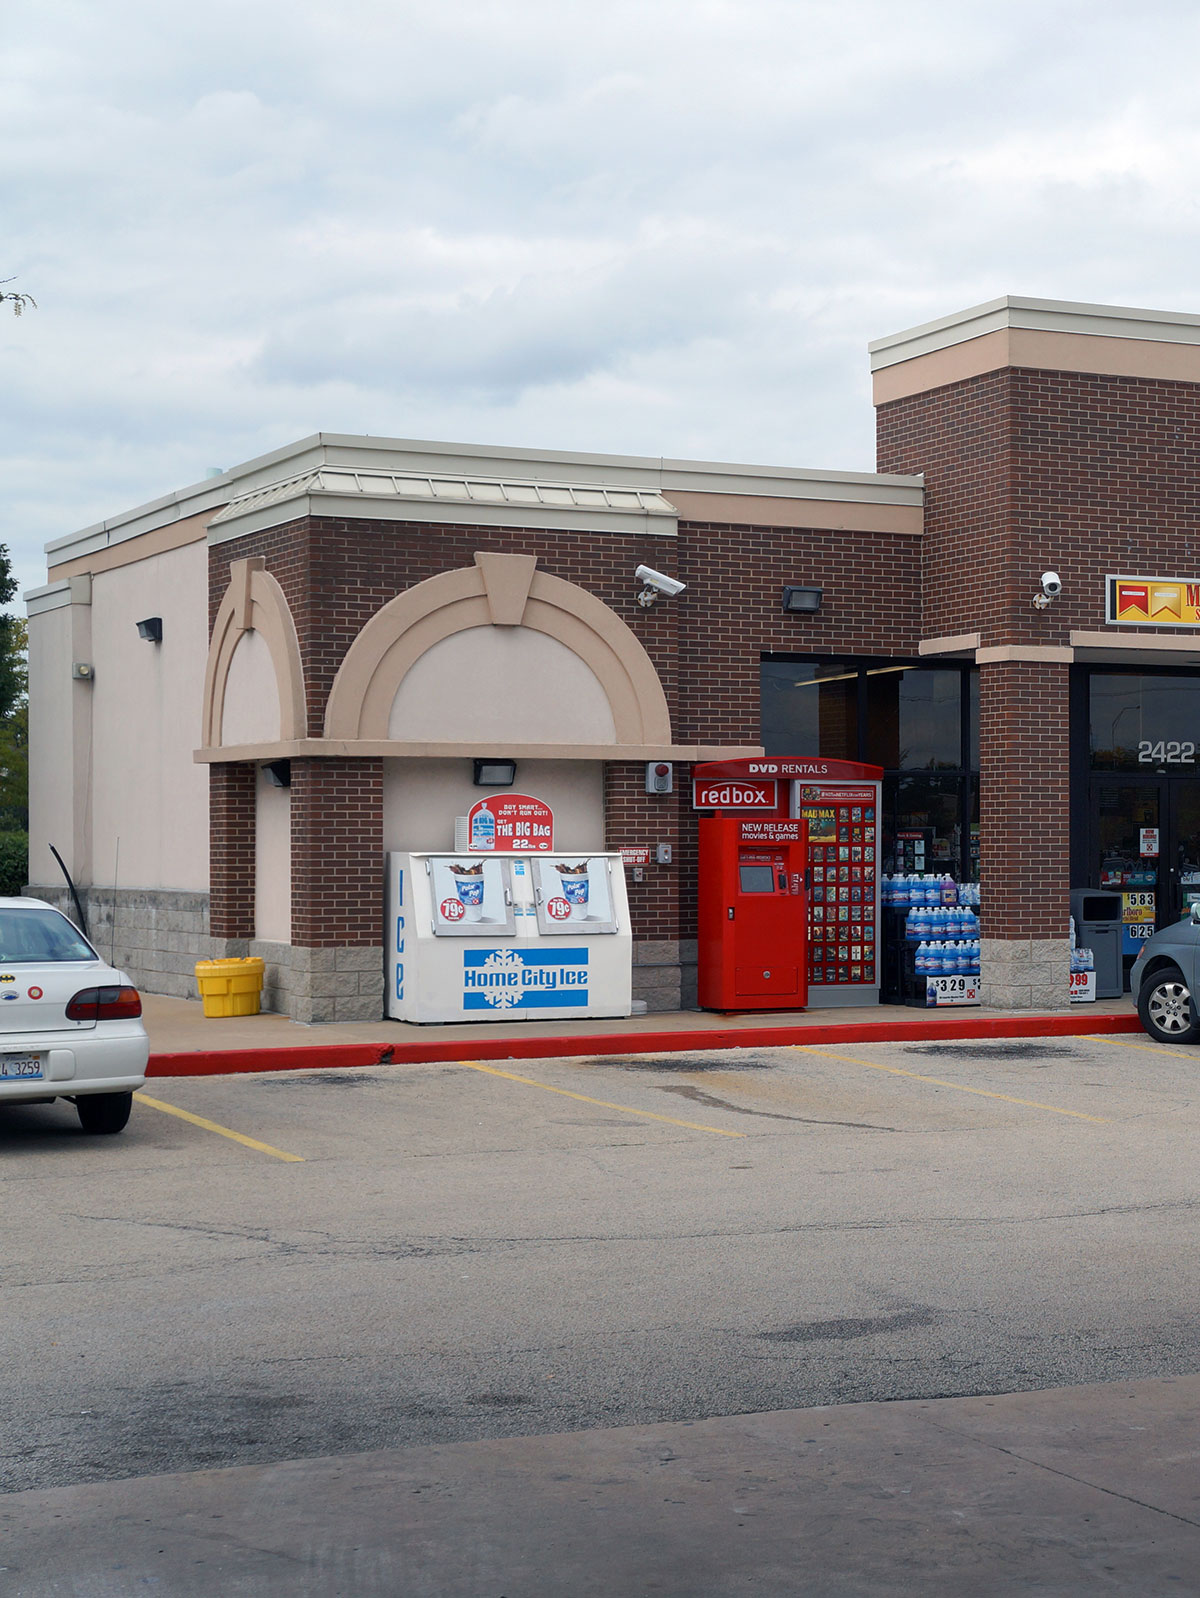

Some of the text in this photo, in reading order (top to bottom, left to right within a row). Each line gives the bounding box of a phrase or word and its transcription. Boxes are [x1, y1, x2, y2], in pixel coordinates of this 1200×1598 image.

[1137, 741, 1195, 763] 2422
[749, 764, 828, 774] DVD RENTALS
[802, 810, 835, 818] MAD MAX
[496, 822, 551, 836] THE BIG BAG
[742, 824, 798, 832] NEW RELEASE
[775, 833, 798, 842] games
[1122, 908, 1142, 916] rlboro
[464, 968, 588, 989] Home City Ice
[14, 1061, 40, 1076] 3259
